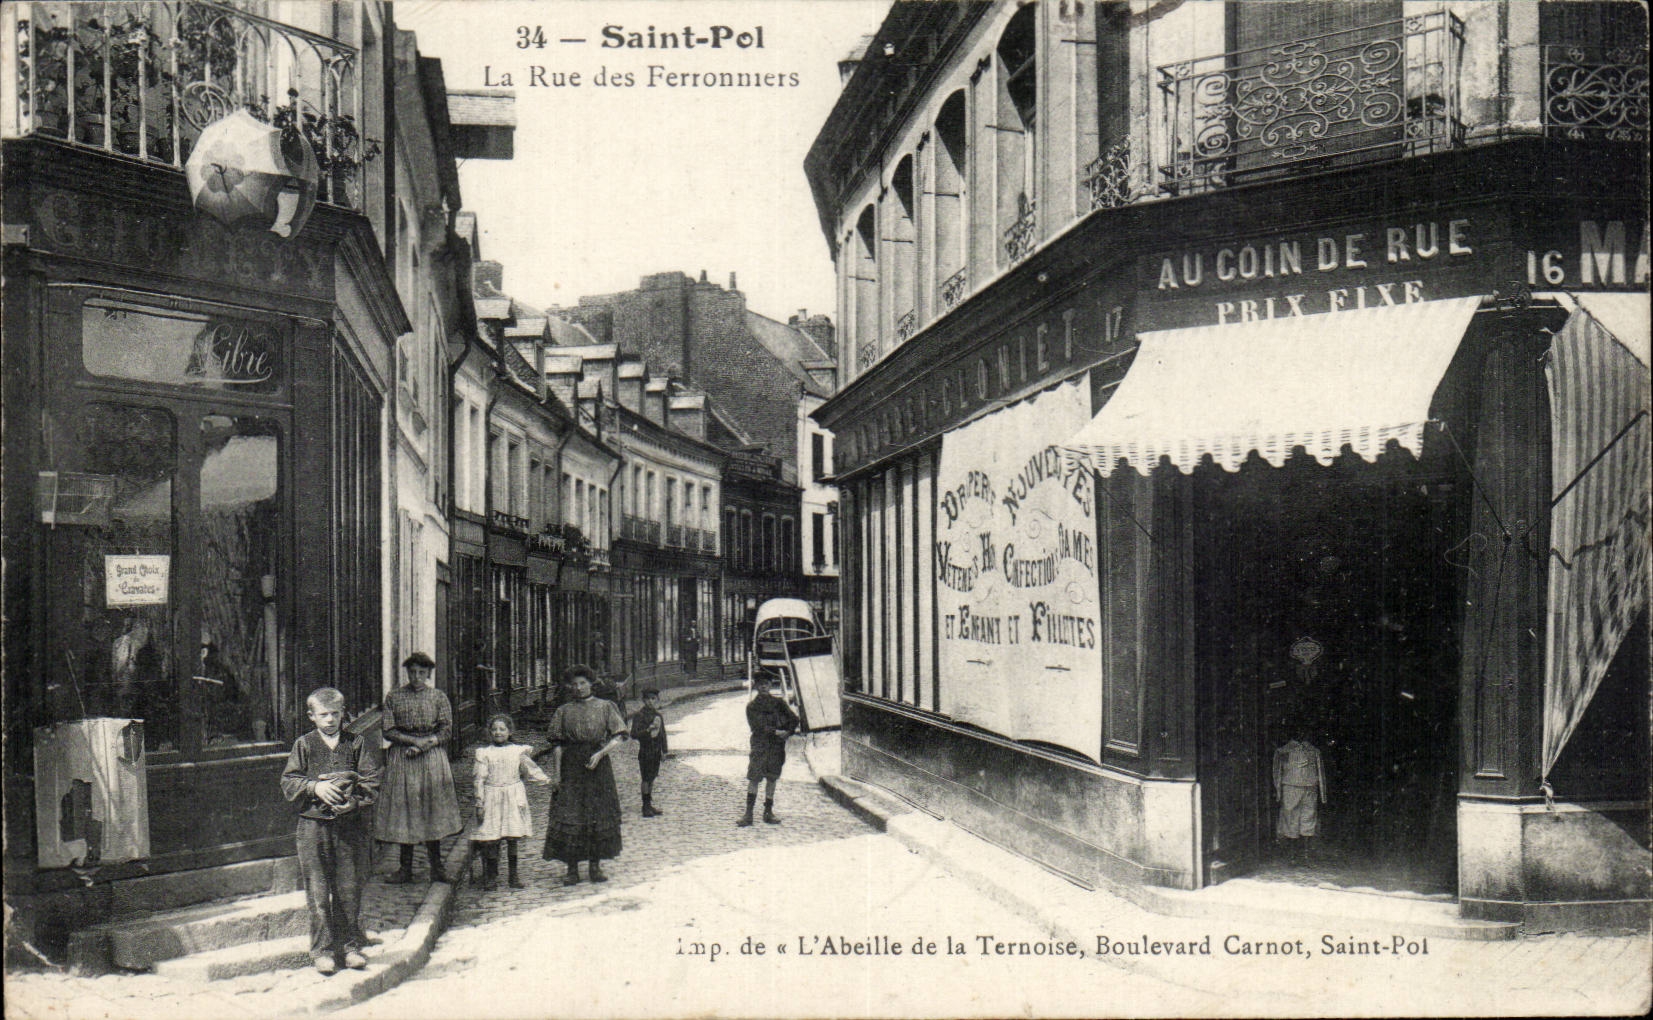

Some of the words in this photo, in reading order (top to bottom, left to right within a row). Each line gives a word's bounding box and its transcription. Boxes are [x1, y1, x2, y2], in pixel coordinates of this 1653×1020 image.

[1158, 252, 1202, 289] AU
[1217, 240, 1302, 281] COIN
[1317, 233, 1368, 272] DE
[1387, 218, 1473, 263] RUE
[1527, 250, 1565, 285] 16
[1216, 294, 1305, 325] PRIX
[1328, 280, 1424, 312] FIXE
[210, 322, 273, 383] Libre
[945, 614, 955, 640] ET
[1008, 615, 1020, 644] ET
